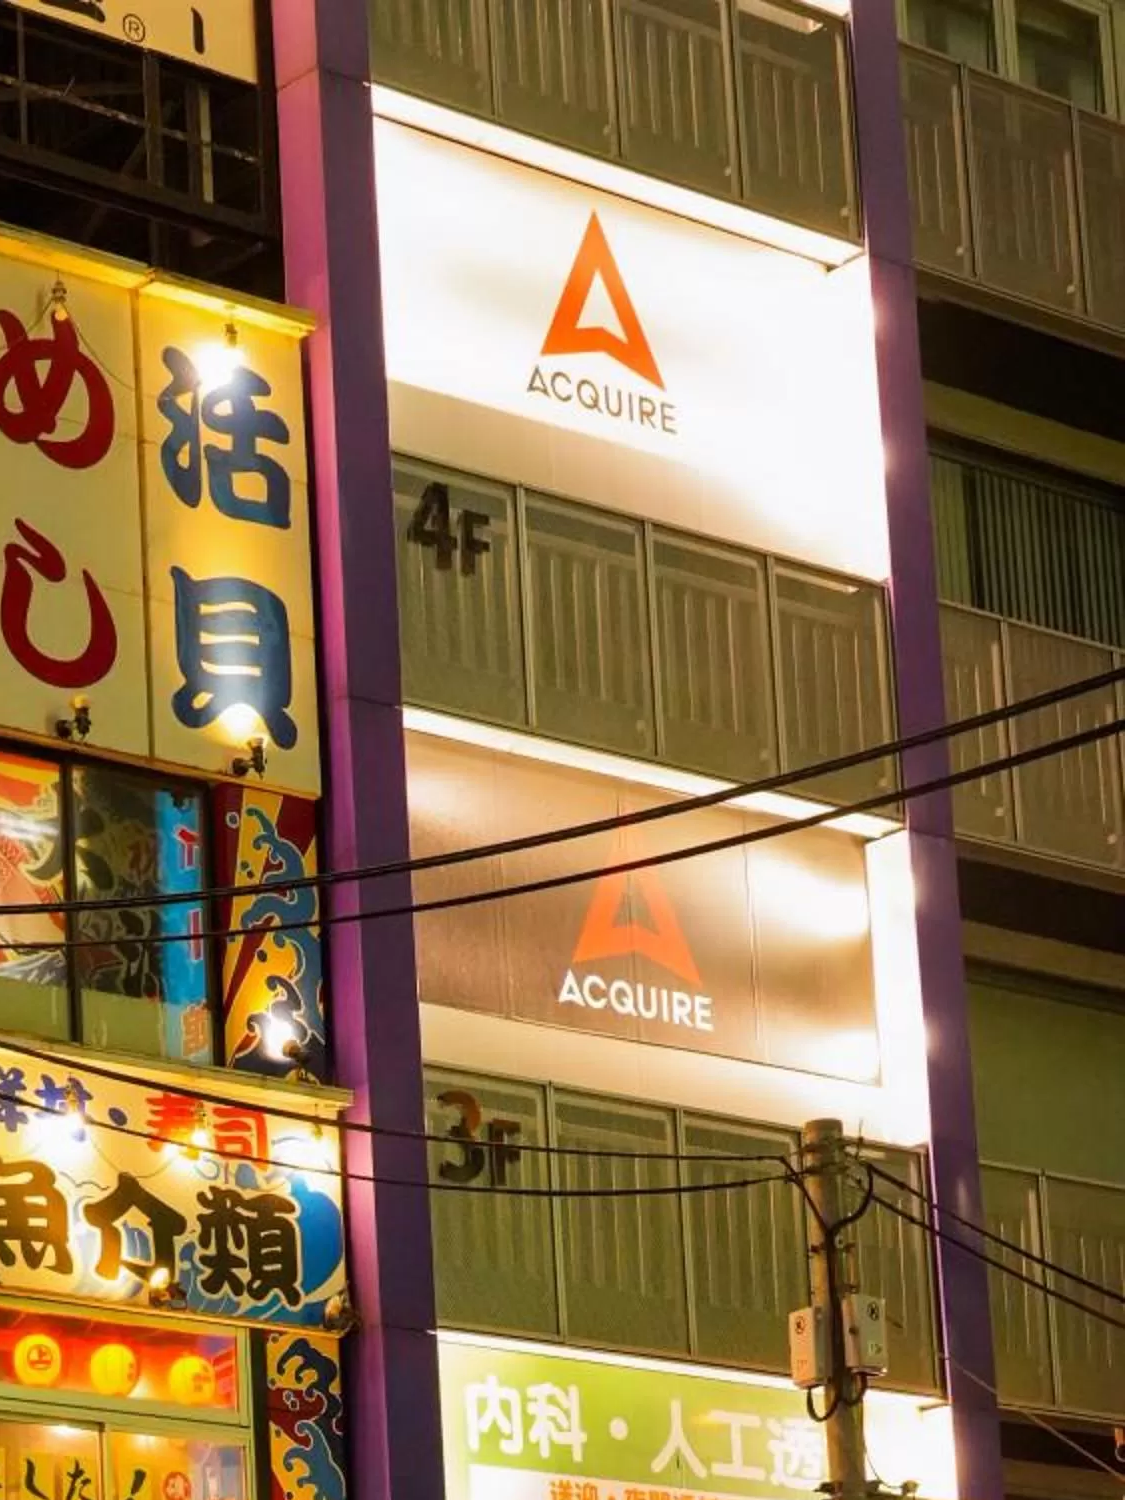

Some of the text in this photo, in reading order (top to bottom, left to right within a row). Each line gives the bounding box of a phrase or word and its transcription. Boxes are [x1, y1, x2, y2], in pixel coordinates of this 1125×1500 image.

[526, 364, 679, 435] ACQUIRE
[156, 345, 298, 750] 活貝
[406, 481, 491, 577] 4F
[558, 968, 715, 1032] ACQUIRE
[436, 1089, 521, 1187] 3F
